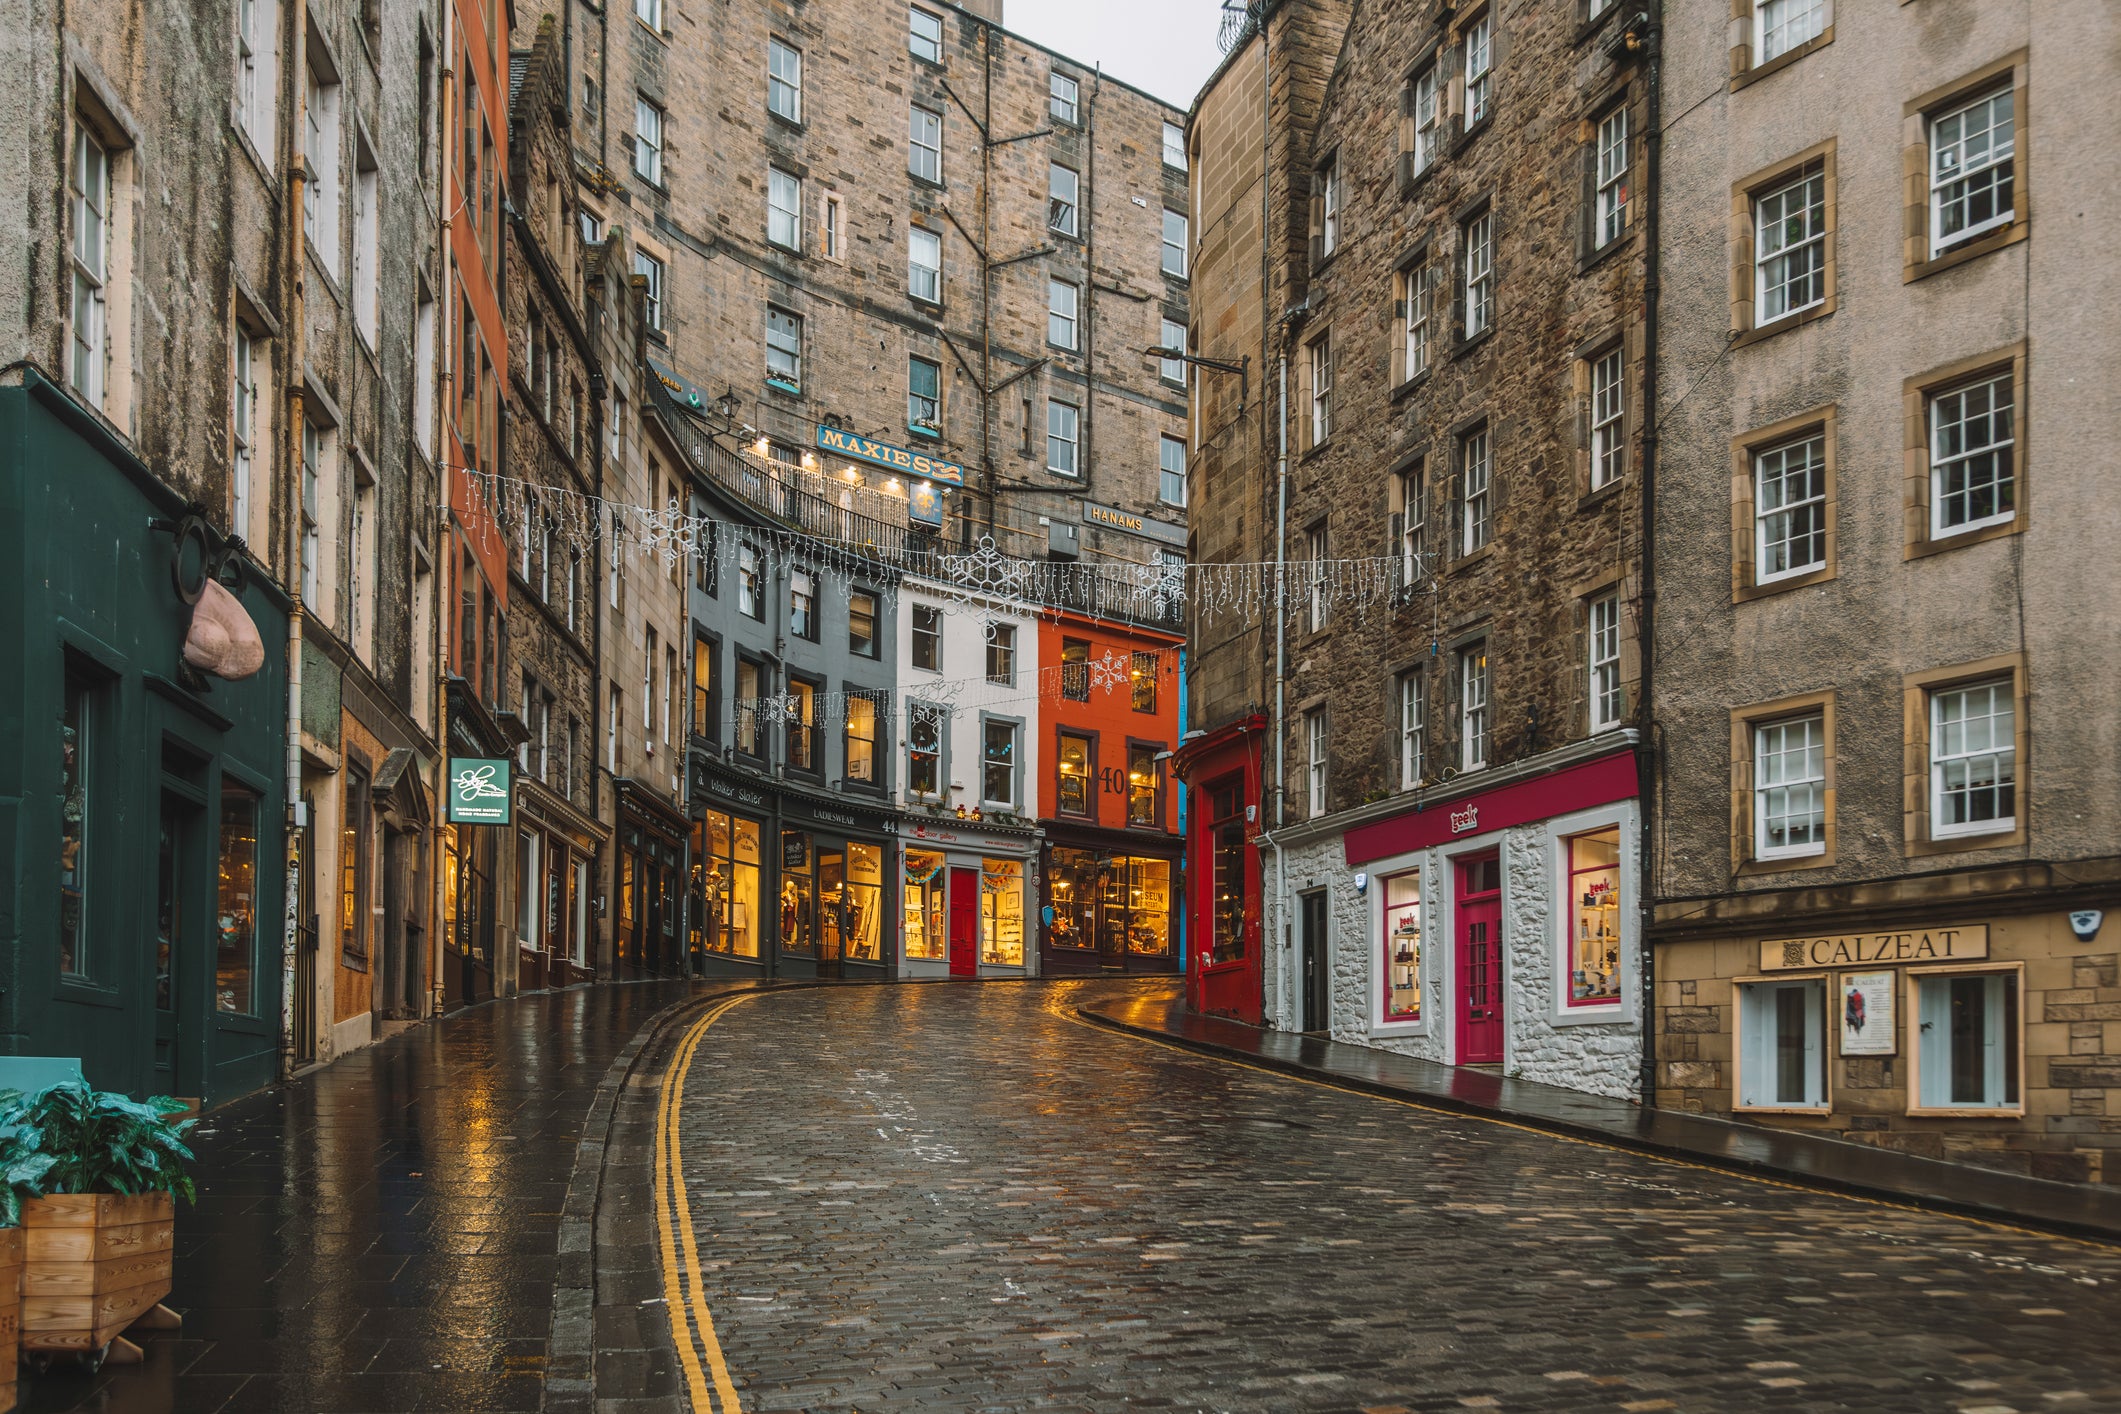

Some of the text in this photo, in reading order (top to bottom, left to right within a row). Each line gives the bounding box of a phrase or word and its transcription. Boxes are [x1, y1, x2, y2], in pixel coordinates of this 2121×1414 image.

[823, 429, 931, 474] MAXIES
[1091, 507, 1143, 531] HANAMS
[1099, 767, 1125, 795] 40
[738, 788, 763, 805] Slater
[813, 809, 855, 825] LADIESWEAR
[1451, 804, 1477, 832] geek
[1590, 877, 1610, 897] geek
[1400, 913, 1416, 929] geek
[1810, 930, 1960, 965] CALZEAT
